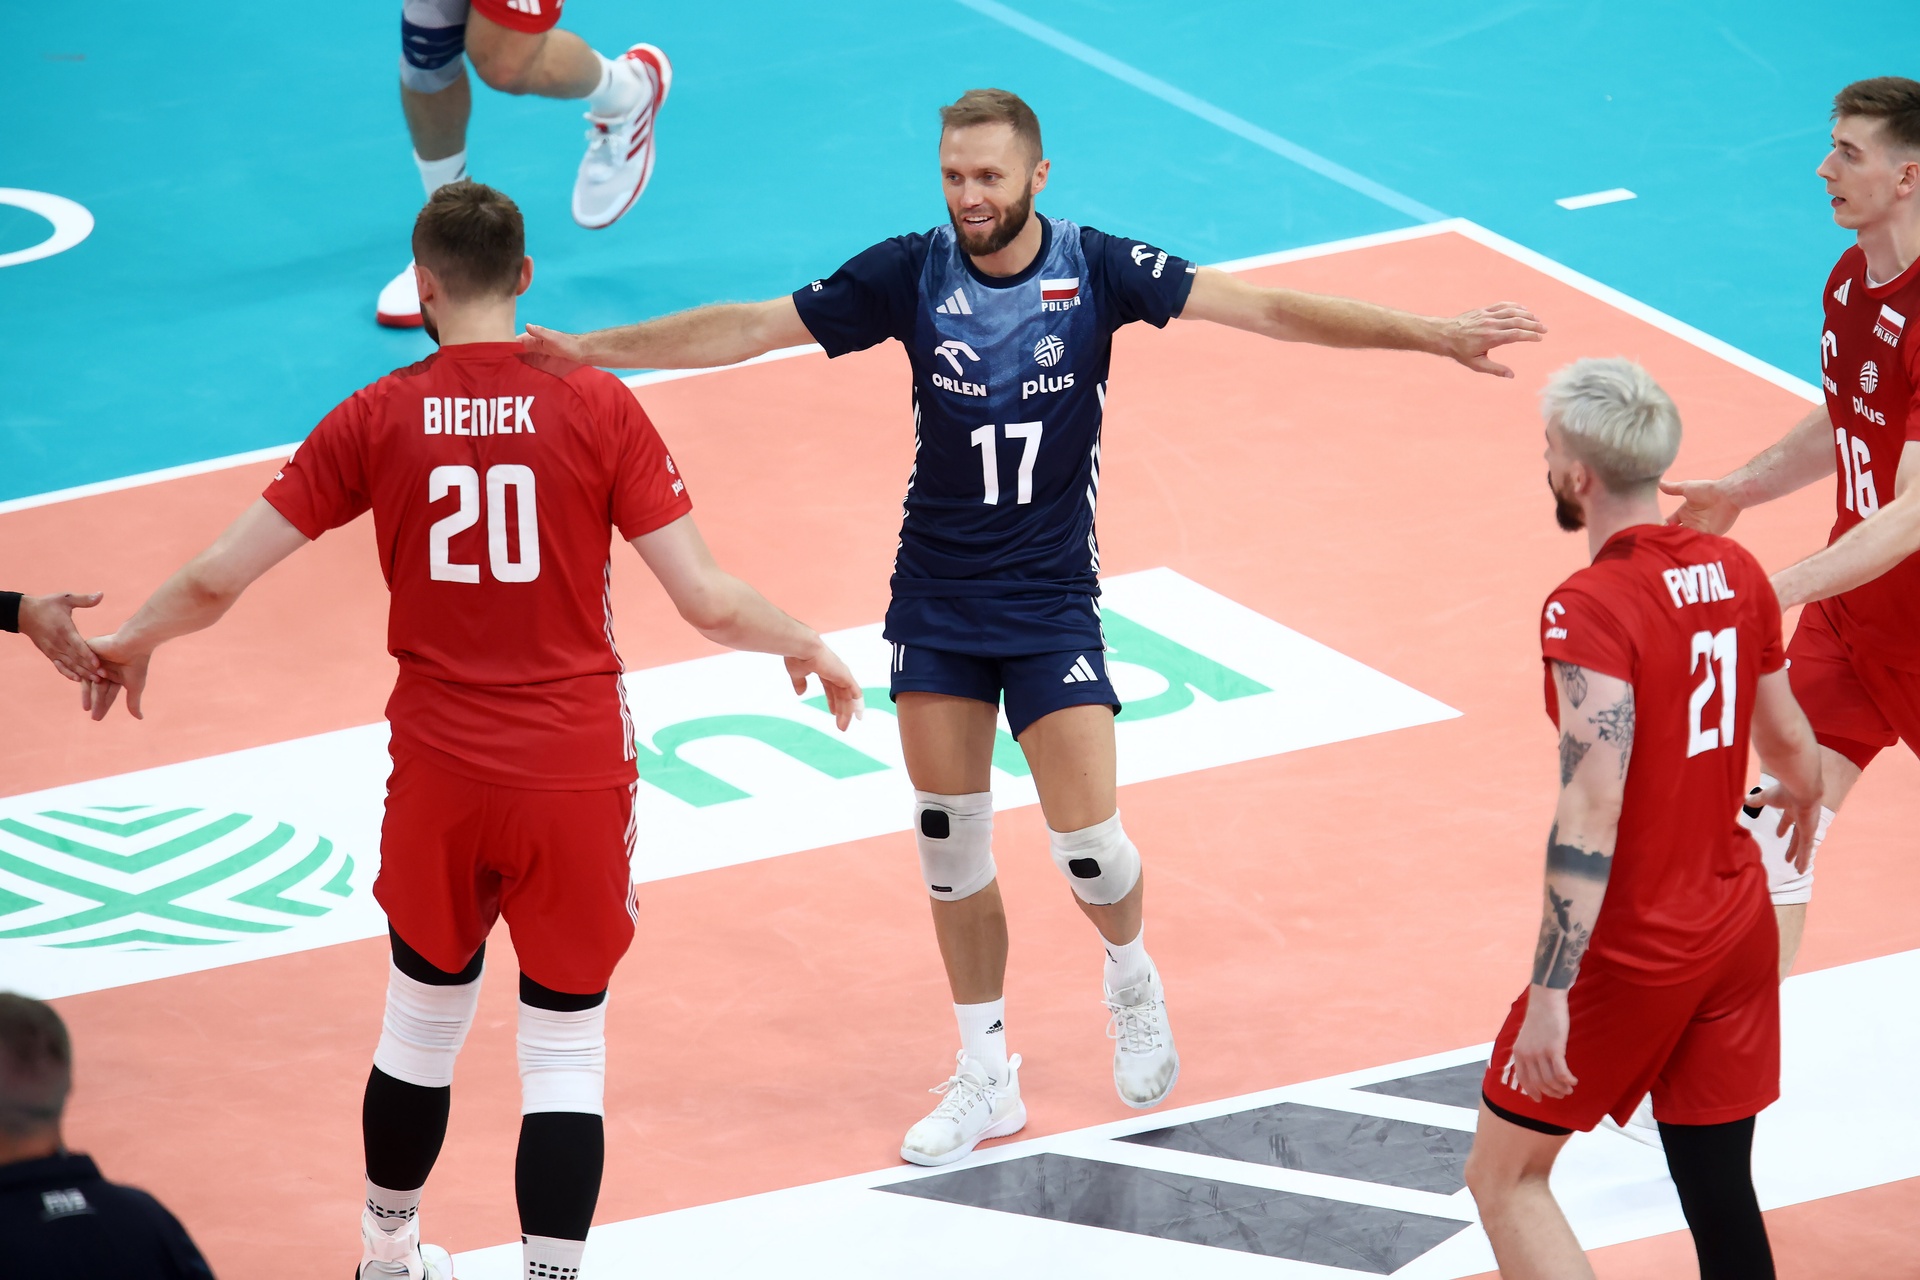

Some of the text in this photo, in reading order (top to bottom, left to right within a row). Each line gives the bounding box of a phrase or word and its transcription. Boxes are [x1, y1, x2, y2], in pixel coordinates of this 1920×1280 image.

[1872, 324, 1899, 348] POLSKA
[931, 373, 987, 397] ORLEN
[1022, 372, 1075, 400] plus
[423, 396, 536, 436] BIENIEK
[1852, 395, 1886, 426] plus
[970, 421, 1043, 506] 17
[1835, 427, 1880, 520] 16
[428, 464, 541, 584] 20
[1686, 627, 1738, 759] 21
